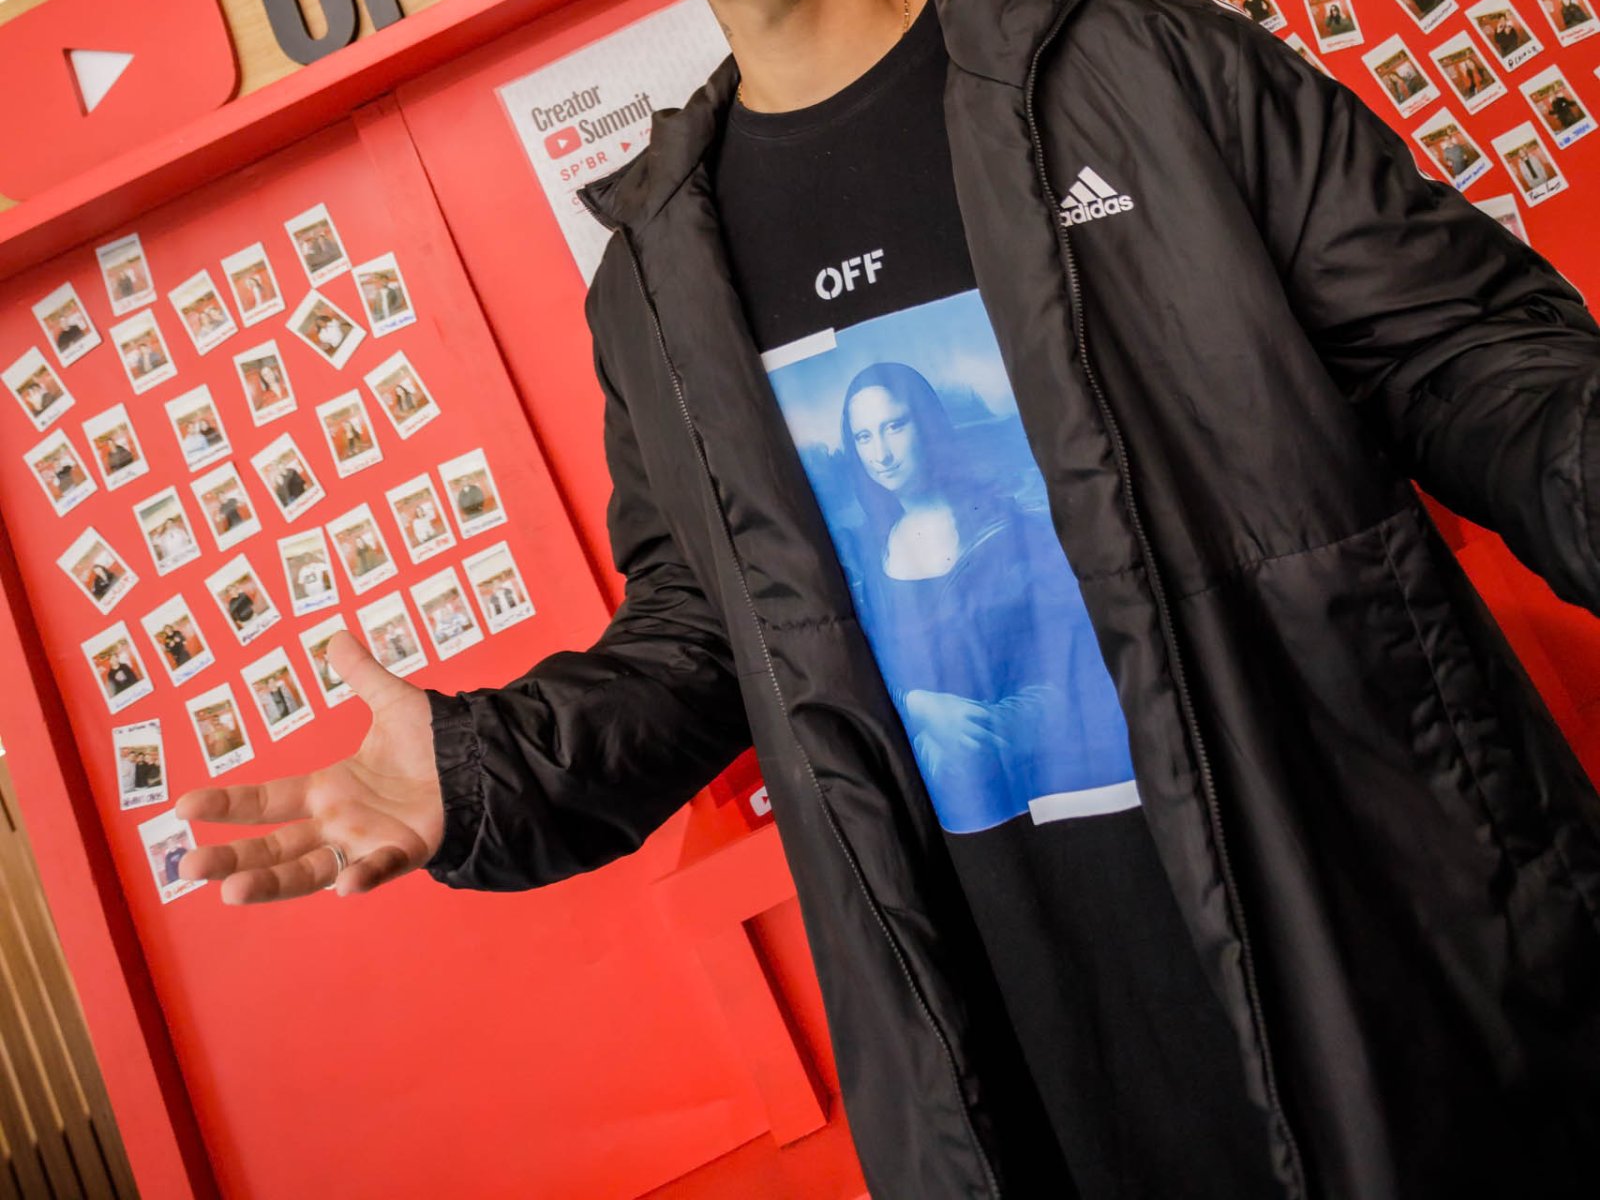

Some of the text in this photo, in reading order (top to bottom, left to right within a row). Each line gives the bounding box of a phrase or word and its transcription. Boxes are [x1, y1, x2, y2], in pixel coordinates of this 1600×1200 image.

[531, 85, 602, 133] Creator
[579, 92, 653, 145] Summit
[1059, 195, 1134, 227] adidas
[815, 248, 884, 300] OFF
